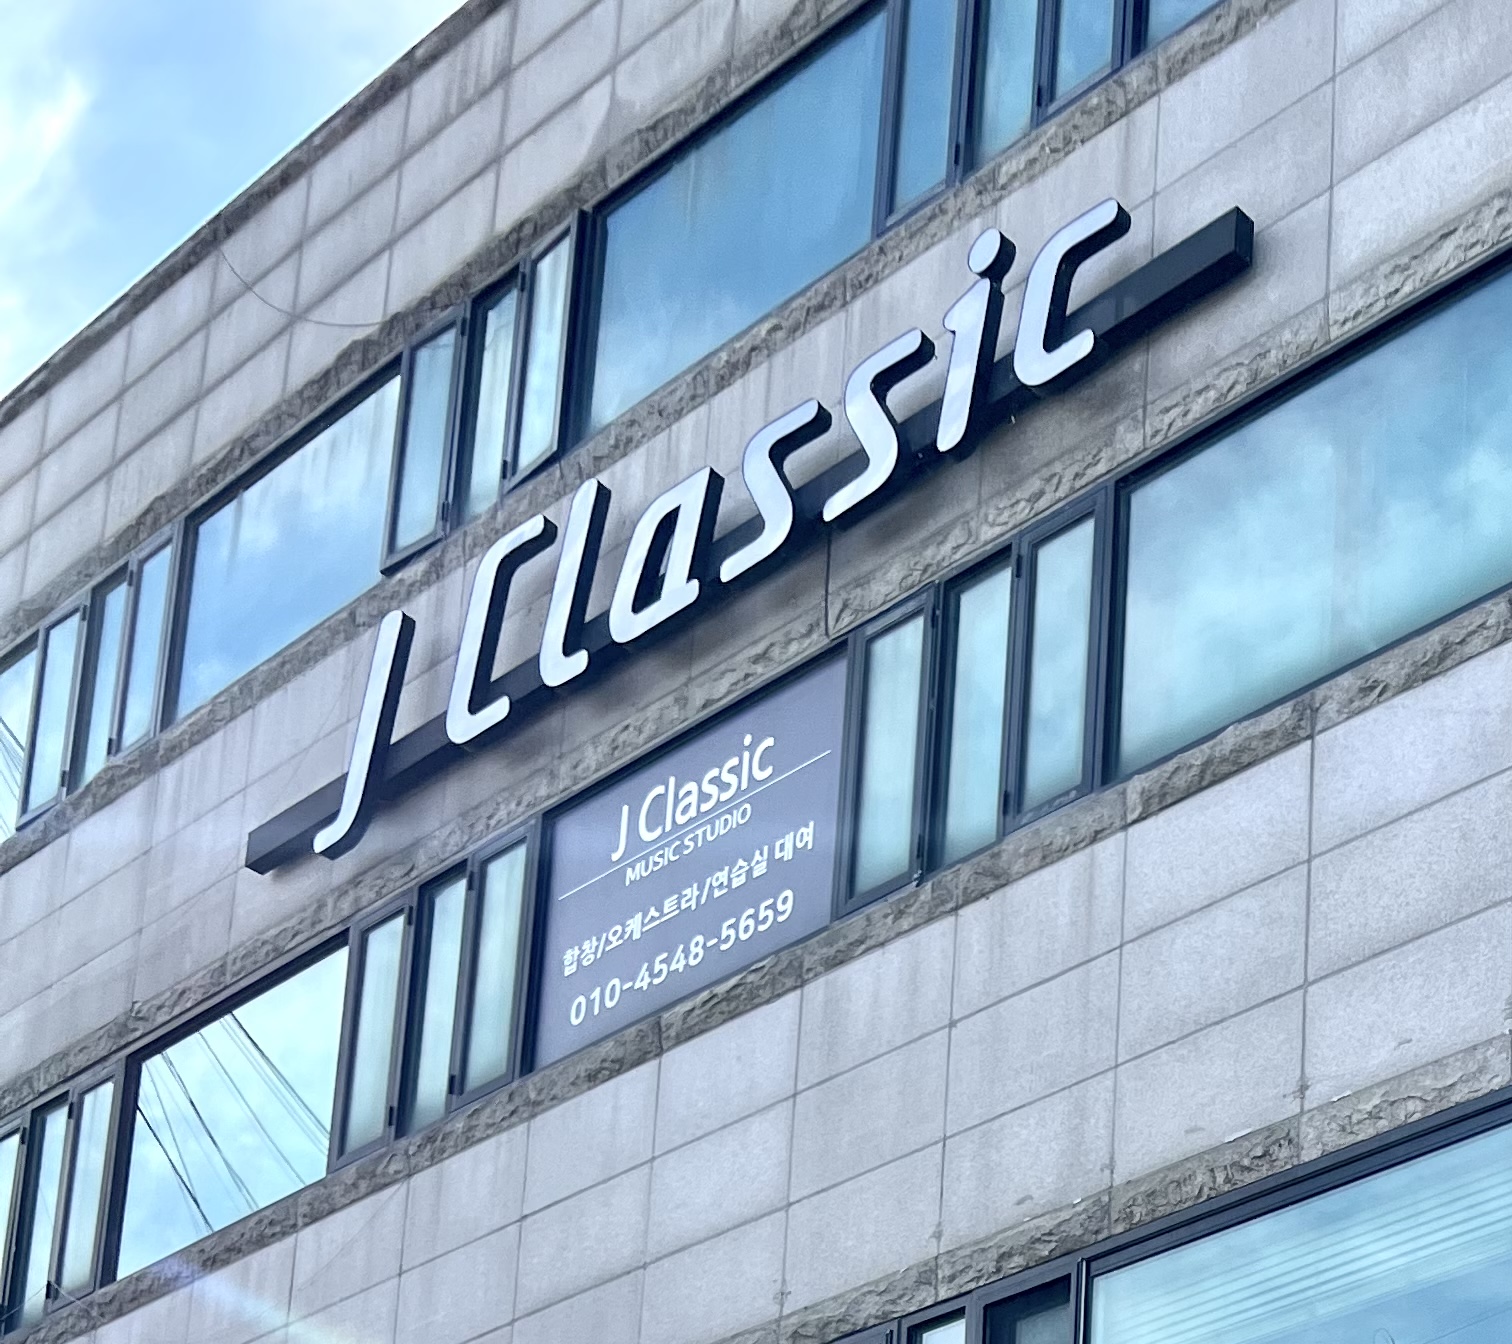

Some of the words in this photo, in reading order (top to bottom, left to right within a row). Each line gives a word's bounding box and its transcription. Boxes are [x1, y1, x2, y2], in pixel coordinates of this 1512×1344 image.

[313, 609, 408, 854] J
[445, 198, 1126, 745] Classic
[611, 804, 629, 862] J
[638, 733, 775, 842] Classic
[625, 849, 680, 886] MUSIC
[683, 803, 752, 857] STUDIO
[774, 821, 815, 862] 대여
[570, 889, 794, 1026] 010-4548-5659
